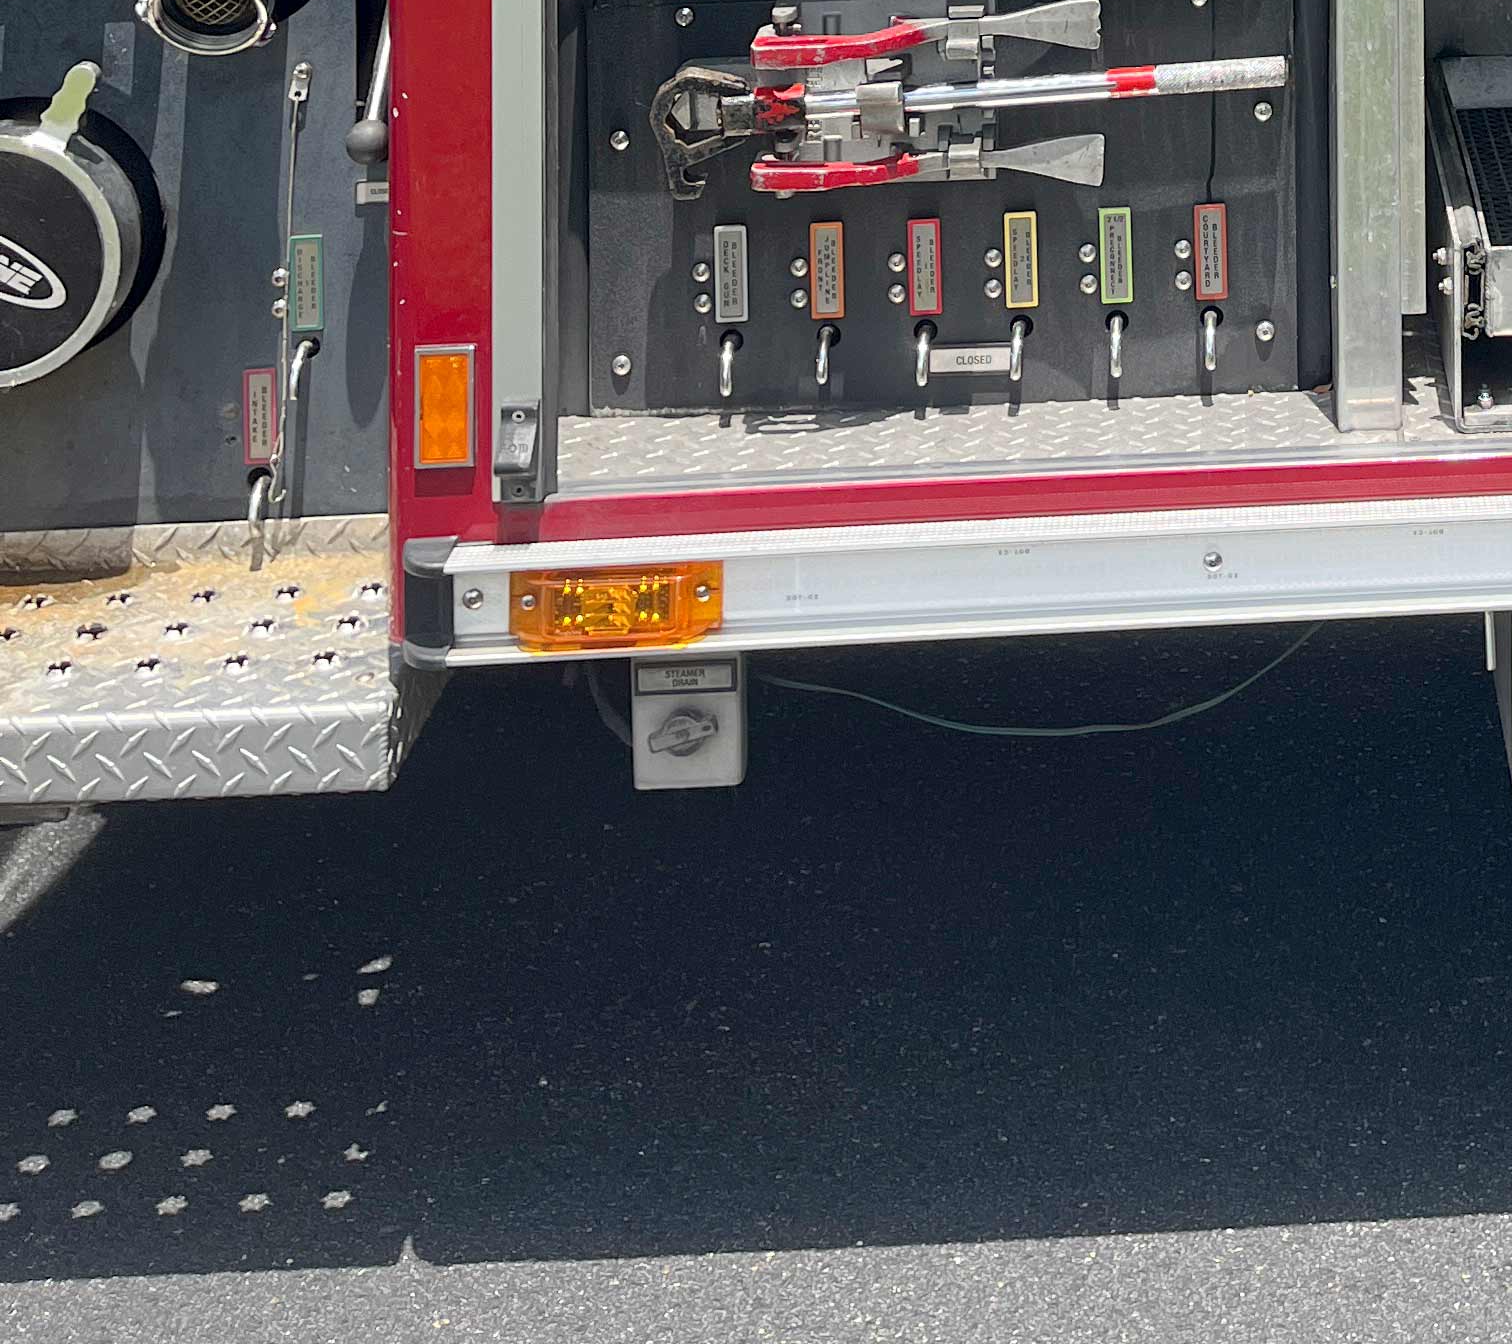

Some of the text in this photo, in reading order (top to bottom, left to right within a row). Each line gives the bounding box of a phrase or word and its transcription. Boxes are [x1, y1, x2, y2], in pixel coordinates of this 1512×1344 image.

[915, 235, 923, 298] SPEEDLAY
[1202, 215, 1211, 288] COURTYARD
[1212, 223, 1220, 279] BLEEDER
[296, 249, 304, 318] DISCHARGE
[955, 355, 992, 366] CLOSED
[664, 668, 706, 679] STEAMER
[672, 678, 699, 688] DRAIN
